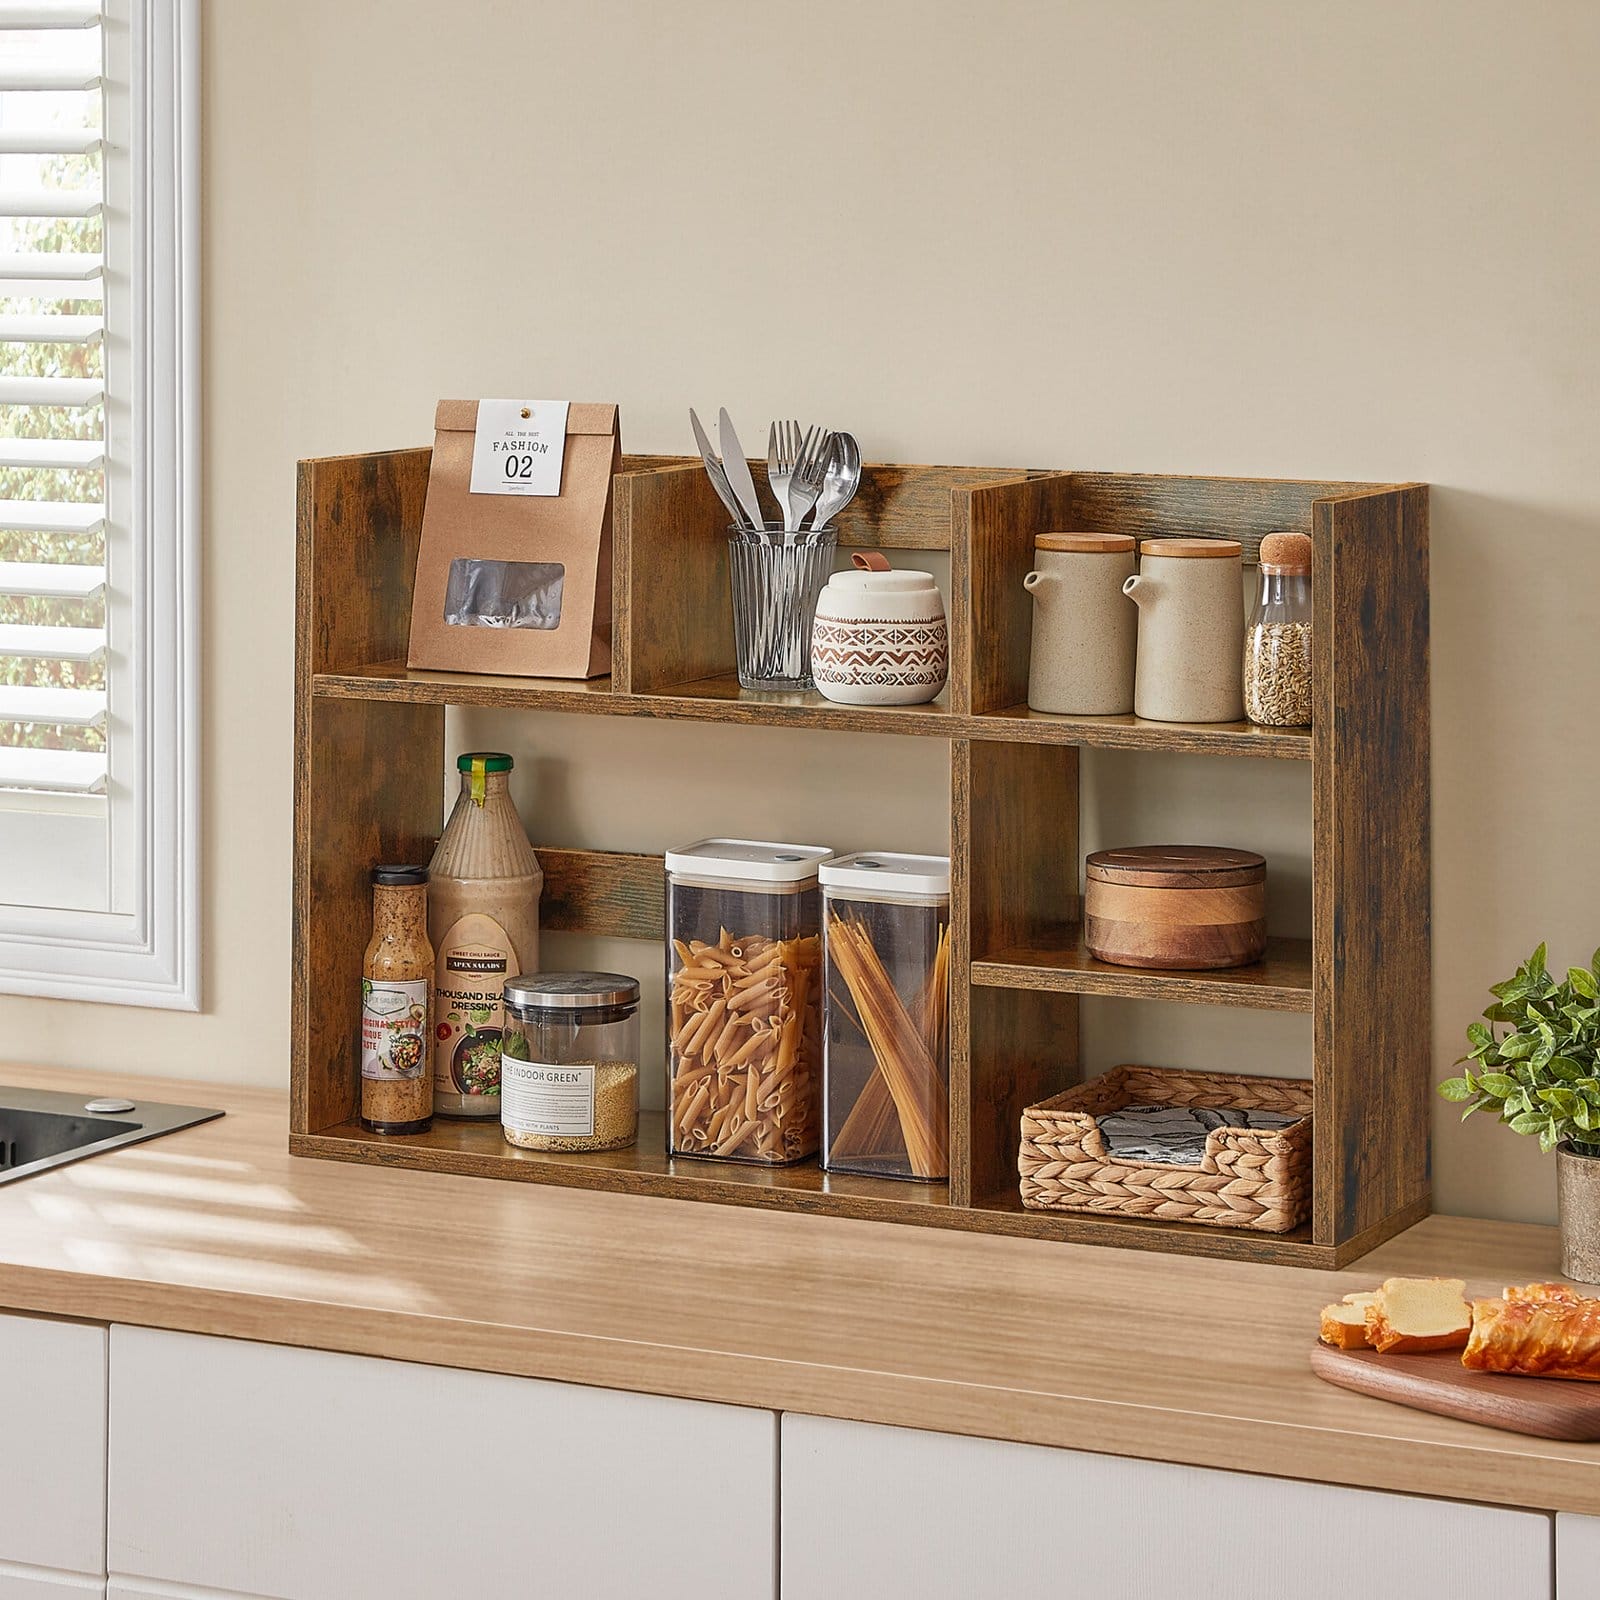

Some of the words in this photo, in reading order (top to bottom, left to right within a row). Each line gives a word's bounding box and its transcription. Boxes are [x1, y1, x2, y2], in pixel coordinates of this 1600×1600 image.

[493, 440, 549, 454] FASHION
[505, 455, 533, 478] 02
[435, 988, 484, 1001] THOUSAND
[485, 992, 504, 1001] ISLA
[451, 1001, 498, 1011] DRESSING
[363, 1040, 377, 1050] ASTE
[513, 1067, 545, 1080] INDOOR
